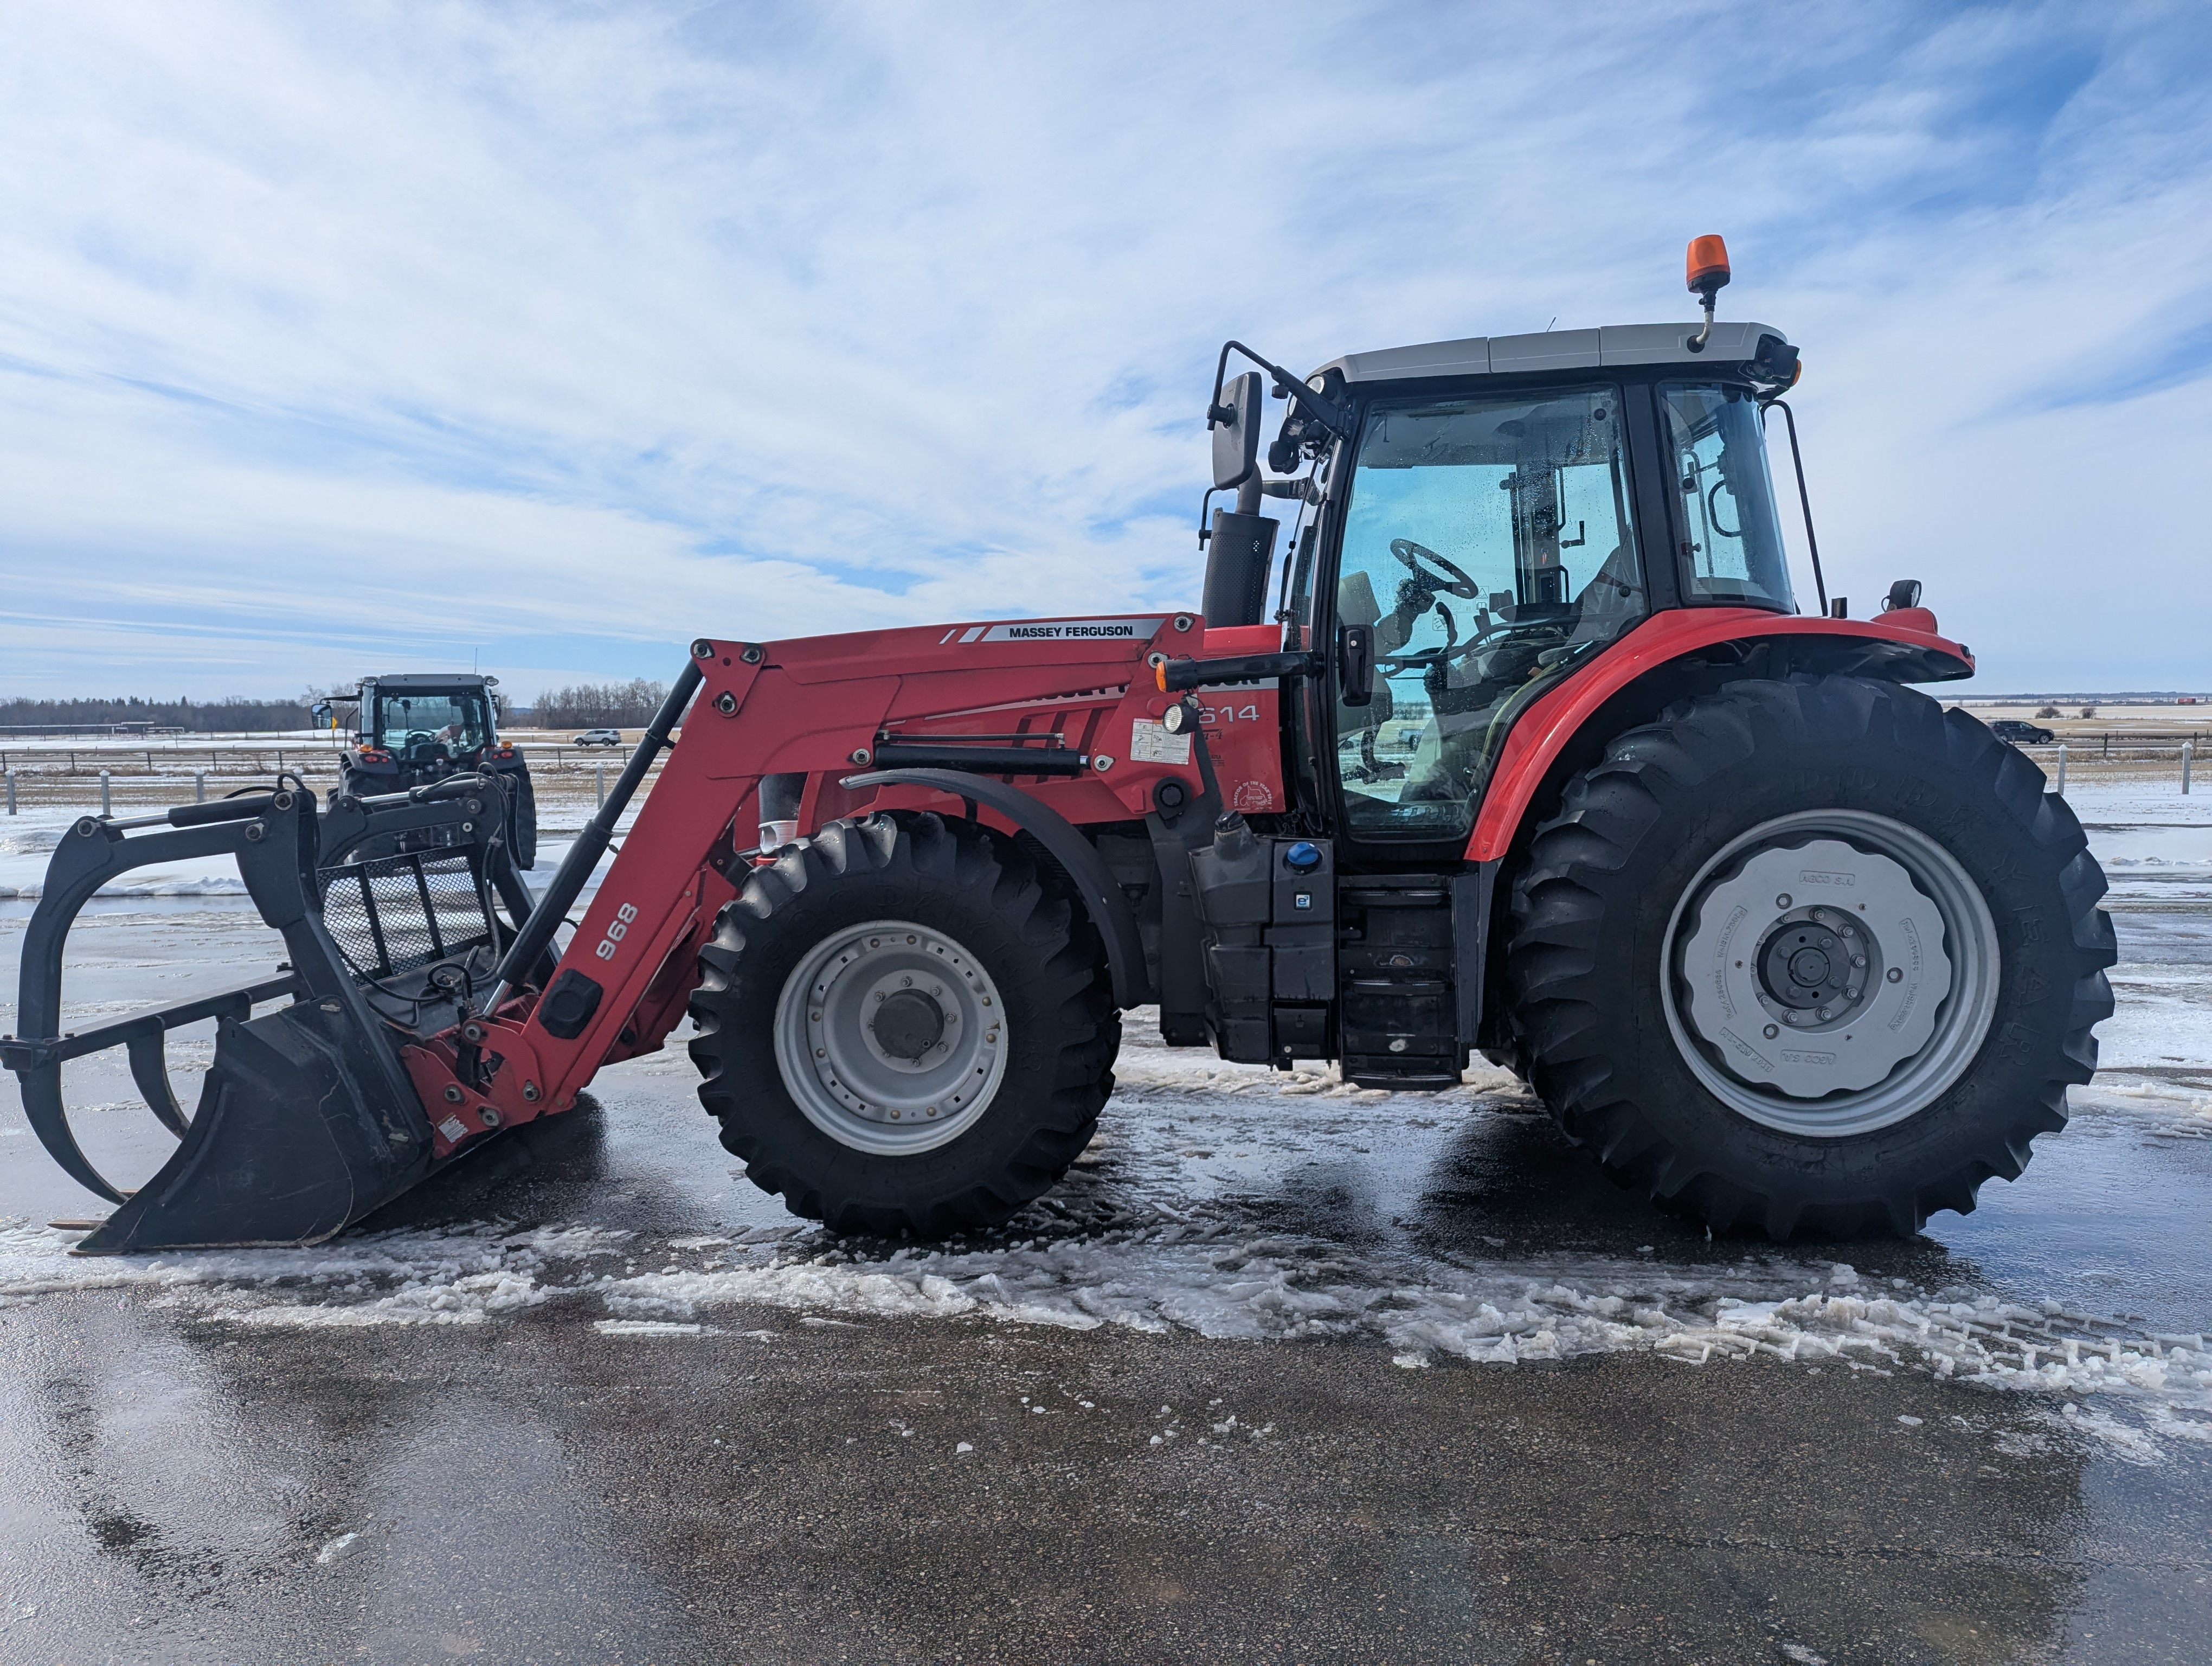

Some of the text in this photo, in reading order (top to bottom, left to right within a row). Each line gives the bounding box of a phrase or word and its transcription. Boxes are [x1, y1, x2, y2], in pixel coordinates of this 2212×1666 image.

[1009, 626, 1133, 638] MASSEY FERGUSON
[1198, 705, 1259, 724] 614
[1233, 785, 1243, 806] TRACTOR
[1800, 874, 1831, 885] AGCO
[596, 902, 638, 960] 968
[1804, 1054, 1835, 1065] AGCO
